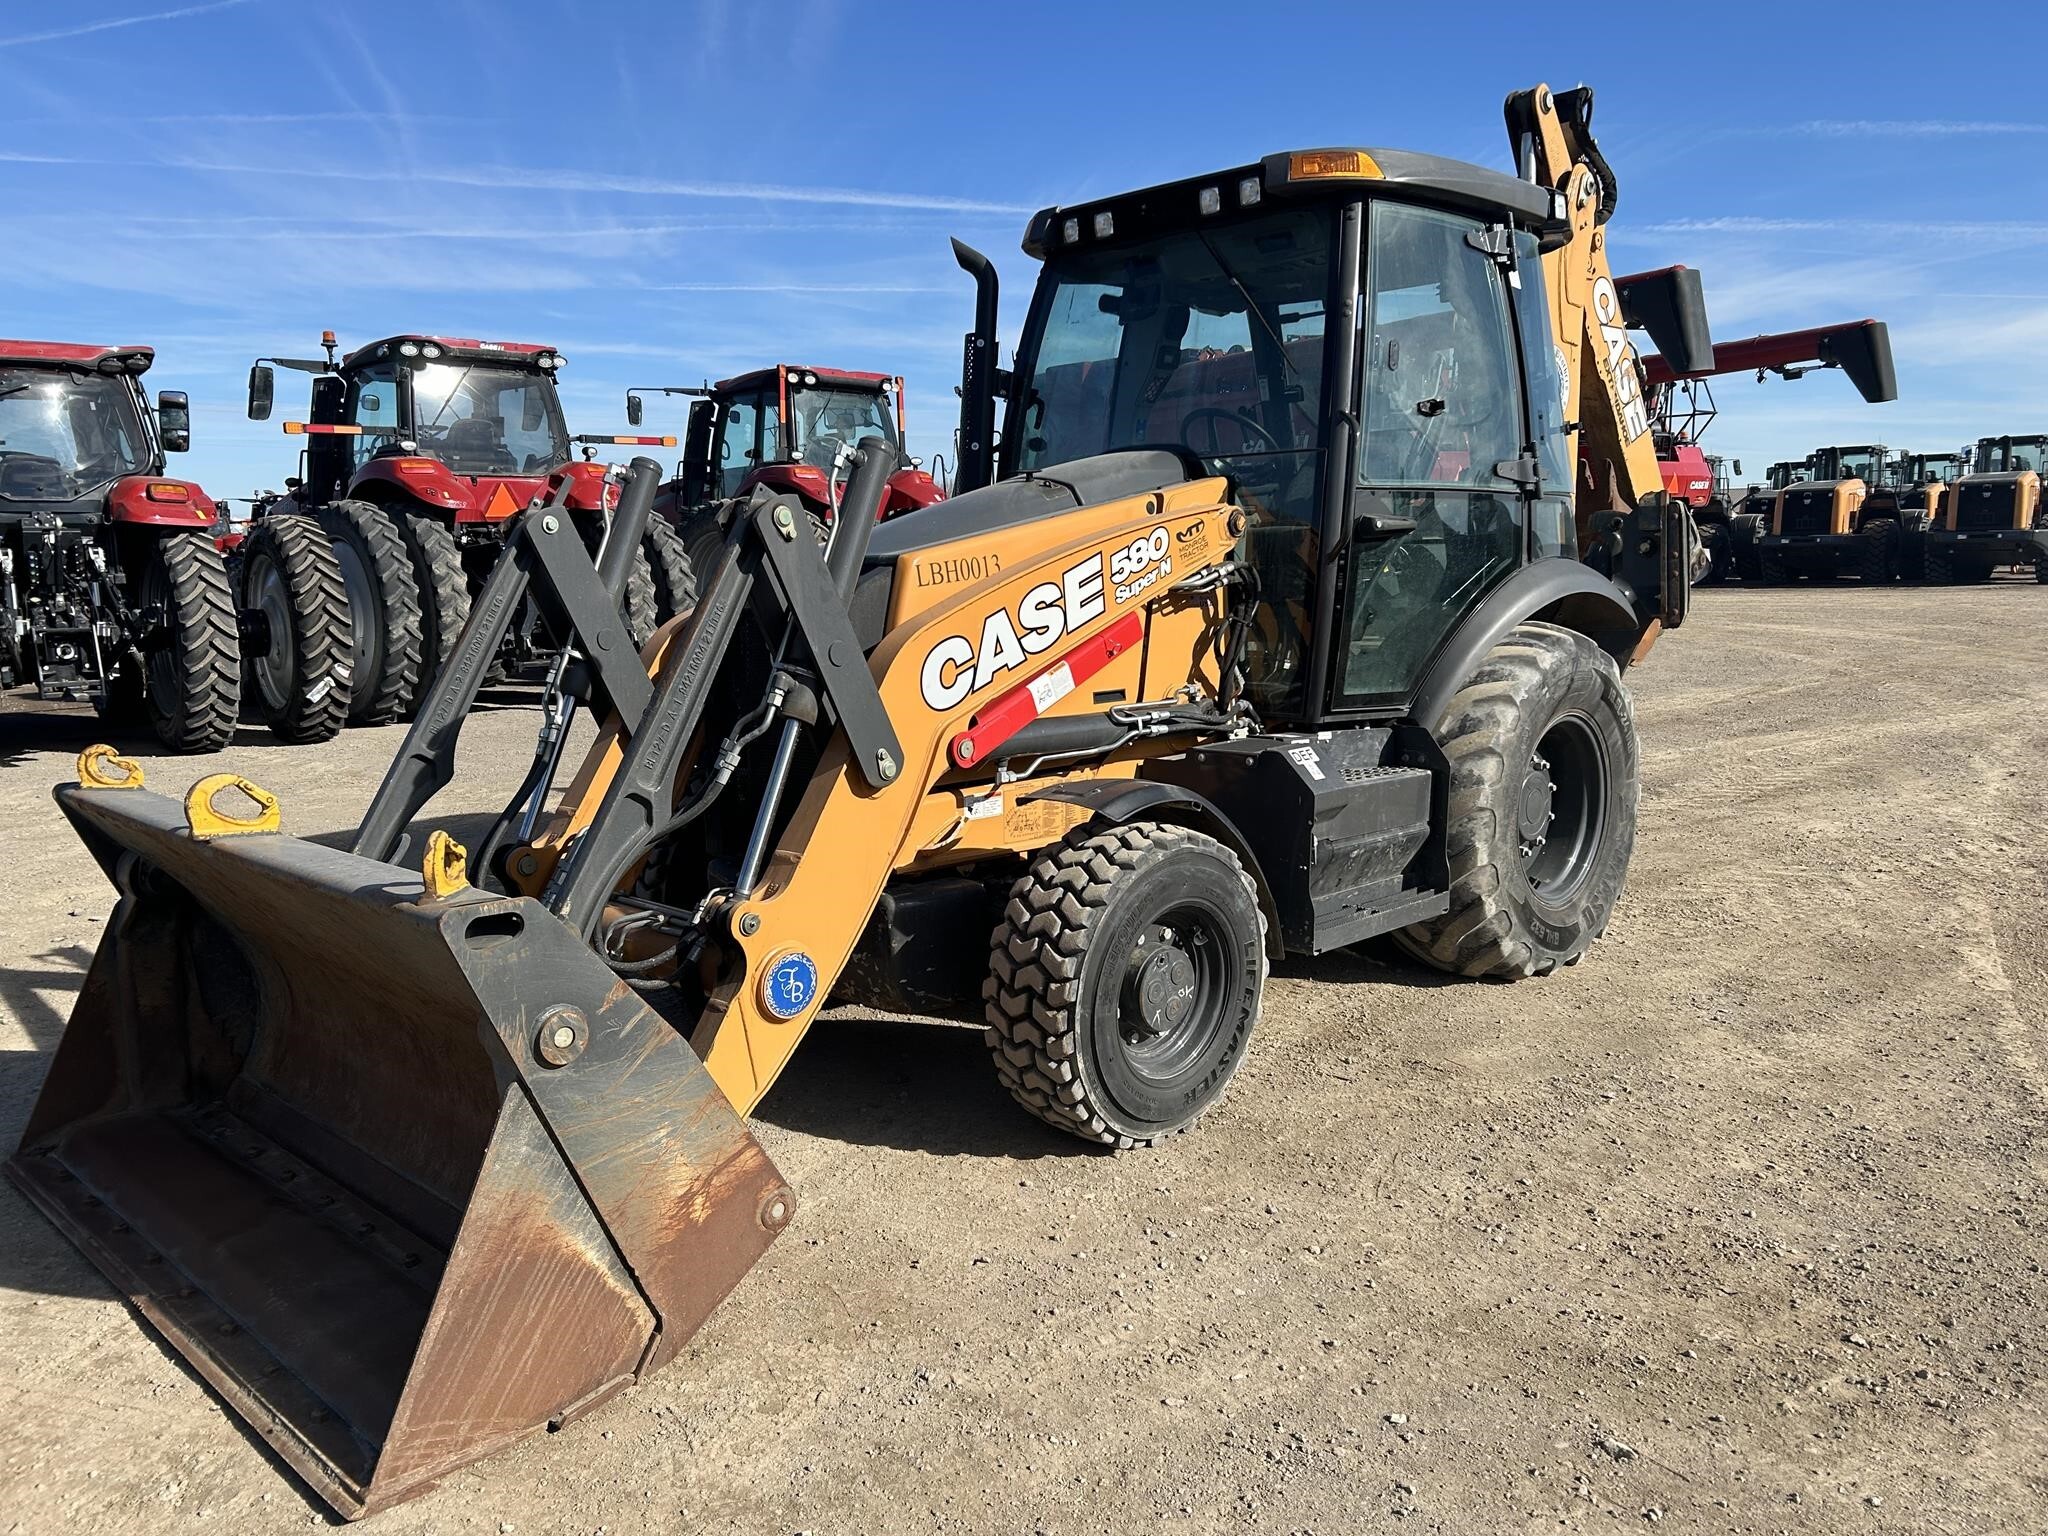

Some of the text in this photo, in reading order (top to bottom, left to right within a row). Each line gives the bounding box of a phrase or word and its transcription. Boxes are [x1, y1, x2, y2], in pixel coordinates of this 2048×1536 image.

[1592, 276, 1649, 443] CASE
[1110, 526, 1170, 585] 580
[1178, 535, 1207, 553] MONROE
[1179, 541, 1209, 561] TRACTOR
[915, 554, 1001, 588] LBH0013
[1115, 567, 1160, 605] Super
[1158, 556, 1173, 580] N
[920, 552, 1106, 712] CASE
[1291, 749, 1314, 763] DEF
